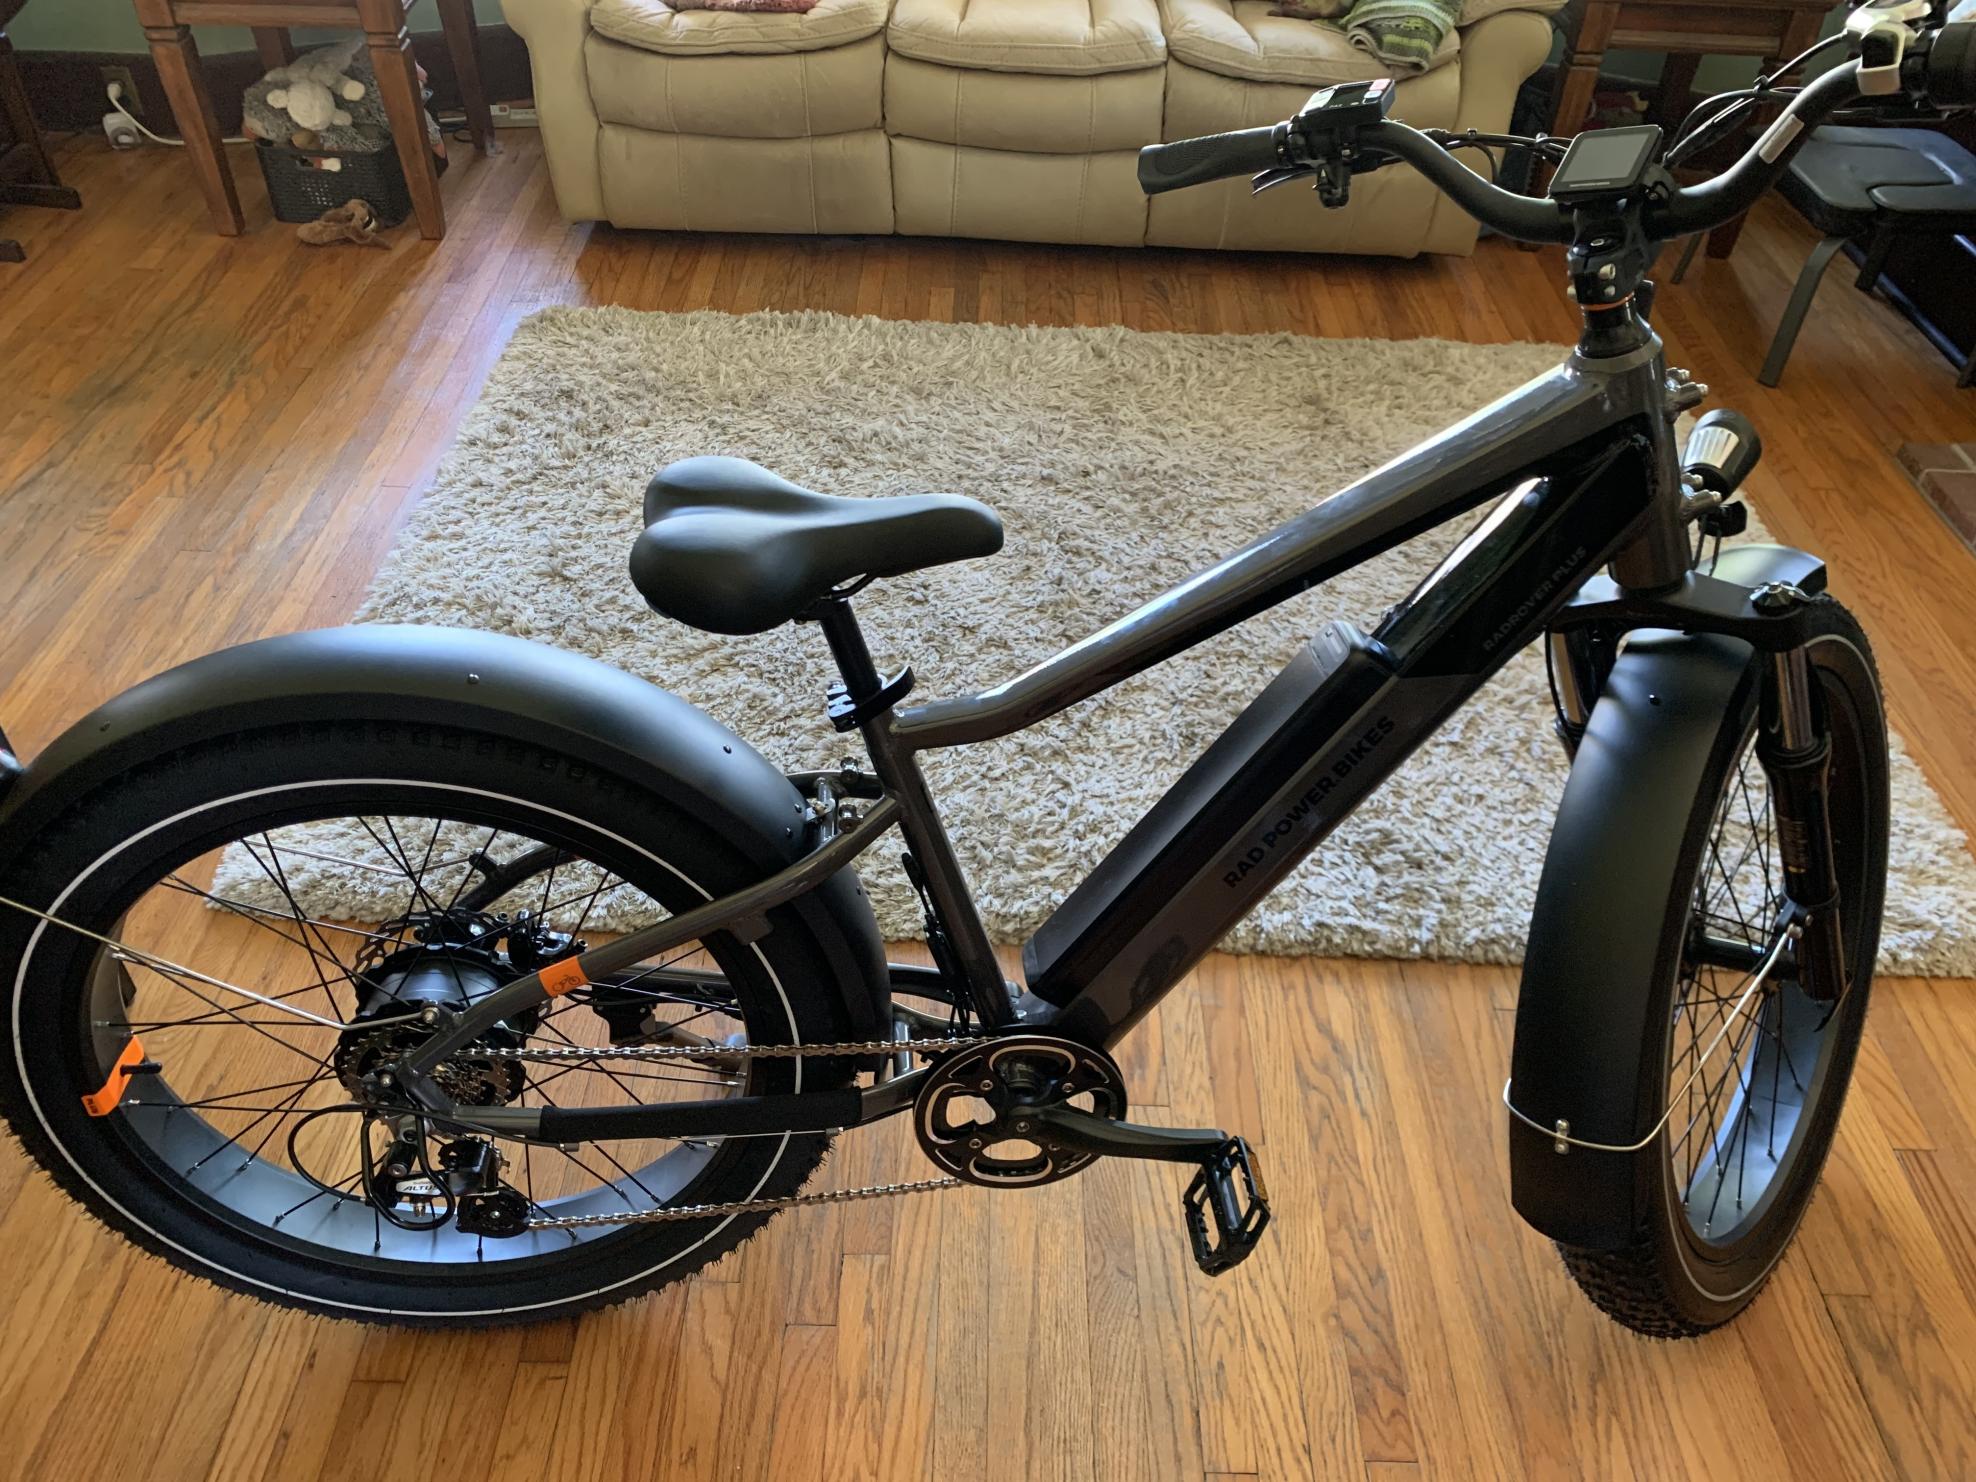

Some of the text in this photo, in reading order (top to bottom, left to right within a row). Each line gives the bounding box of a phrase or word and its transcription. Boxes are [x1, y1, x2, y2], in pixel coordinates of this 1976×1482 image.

[1551, 545, 1587, 582] PLUS
[1223, 716, 1395, 888] RAD POWER BIKES
